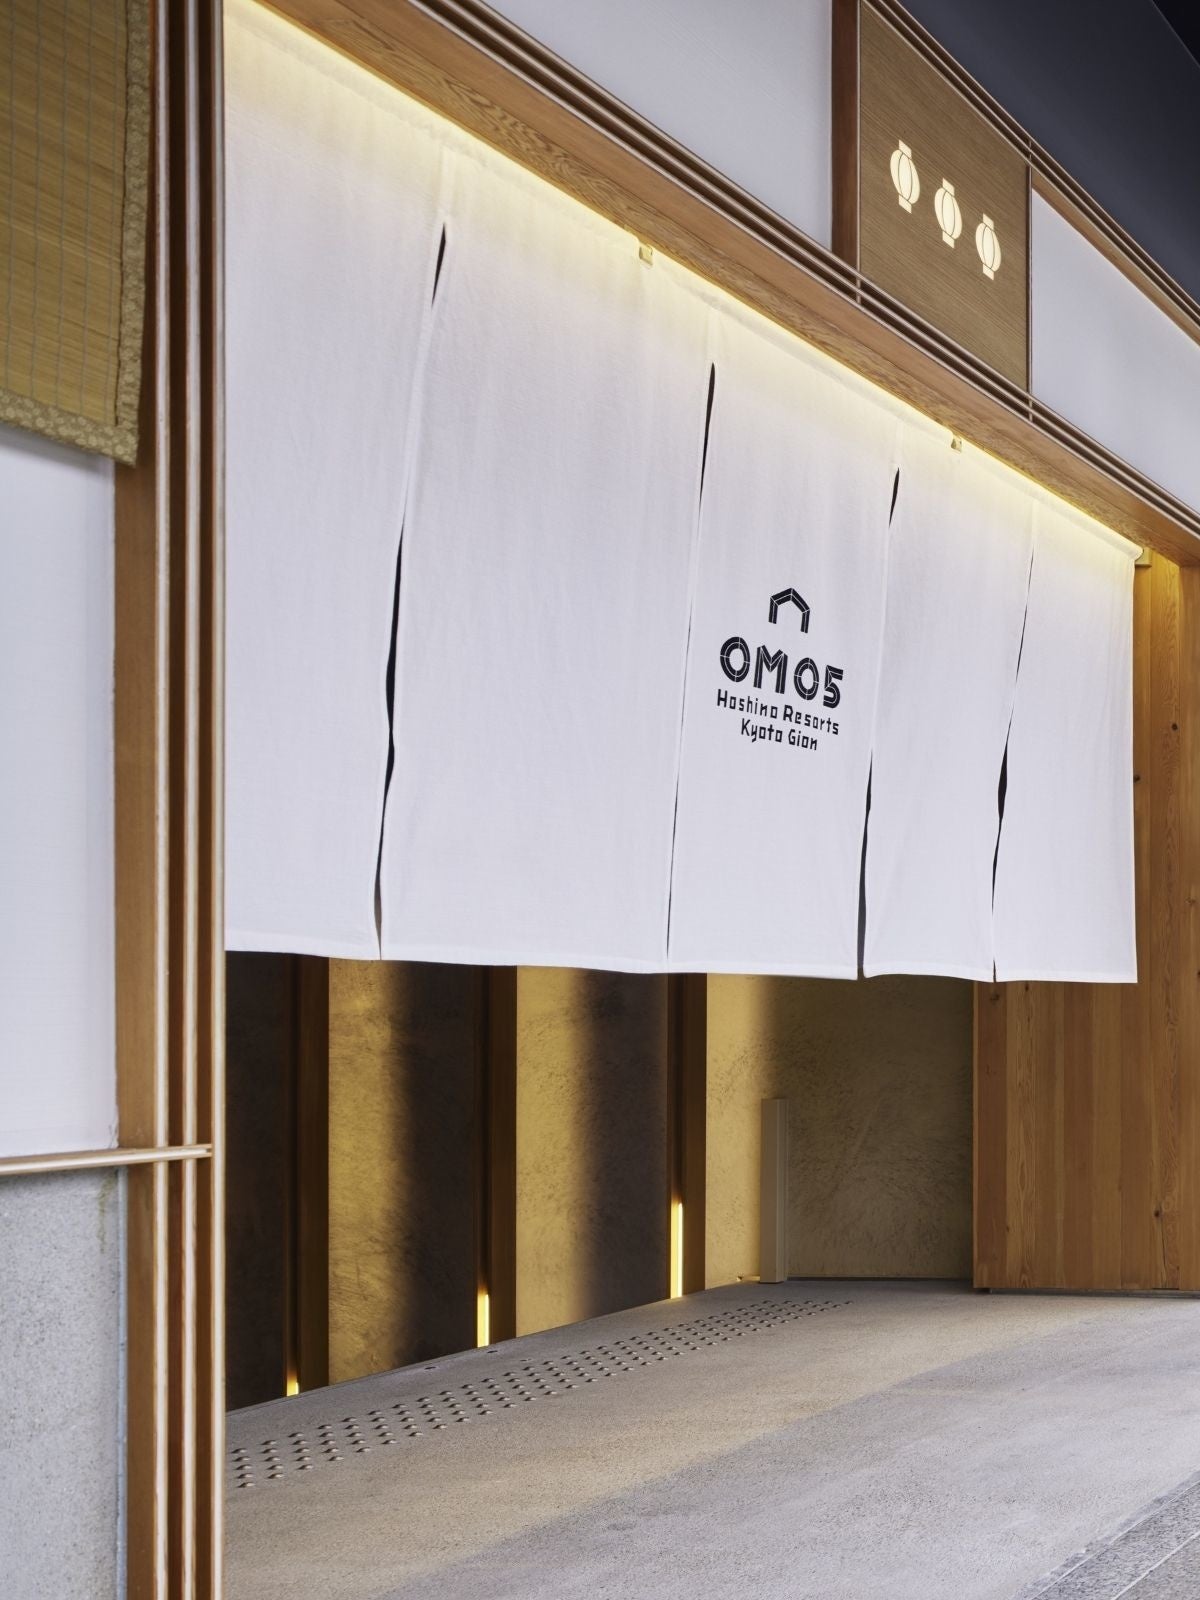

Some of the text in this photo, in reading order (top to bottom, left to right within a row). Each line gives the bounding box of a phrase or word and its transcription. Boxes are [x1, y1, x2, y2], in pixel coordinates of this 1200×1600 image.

[719, 636, 844, 709] OMO5
[717, 688, 839, 735] Hoshino Resorts
[741, 717, 818, 751] Kyoto Gion
